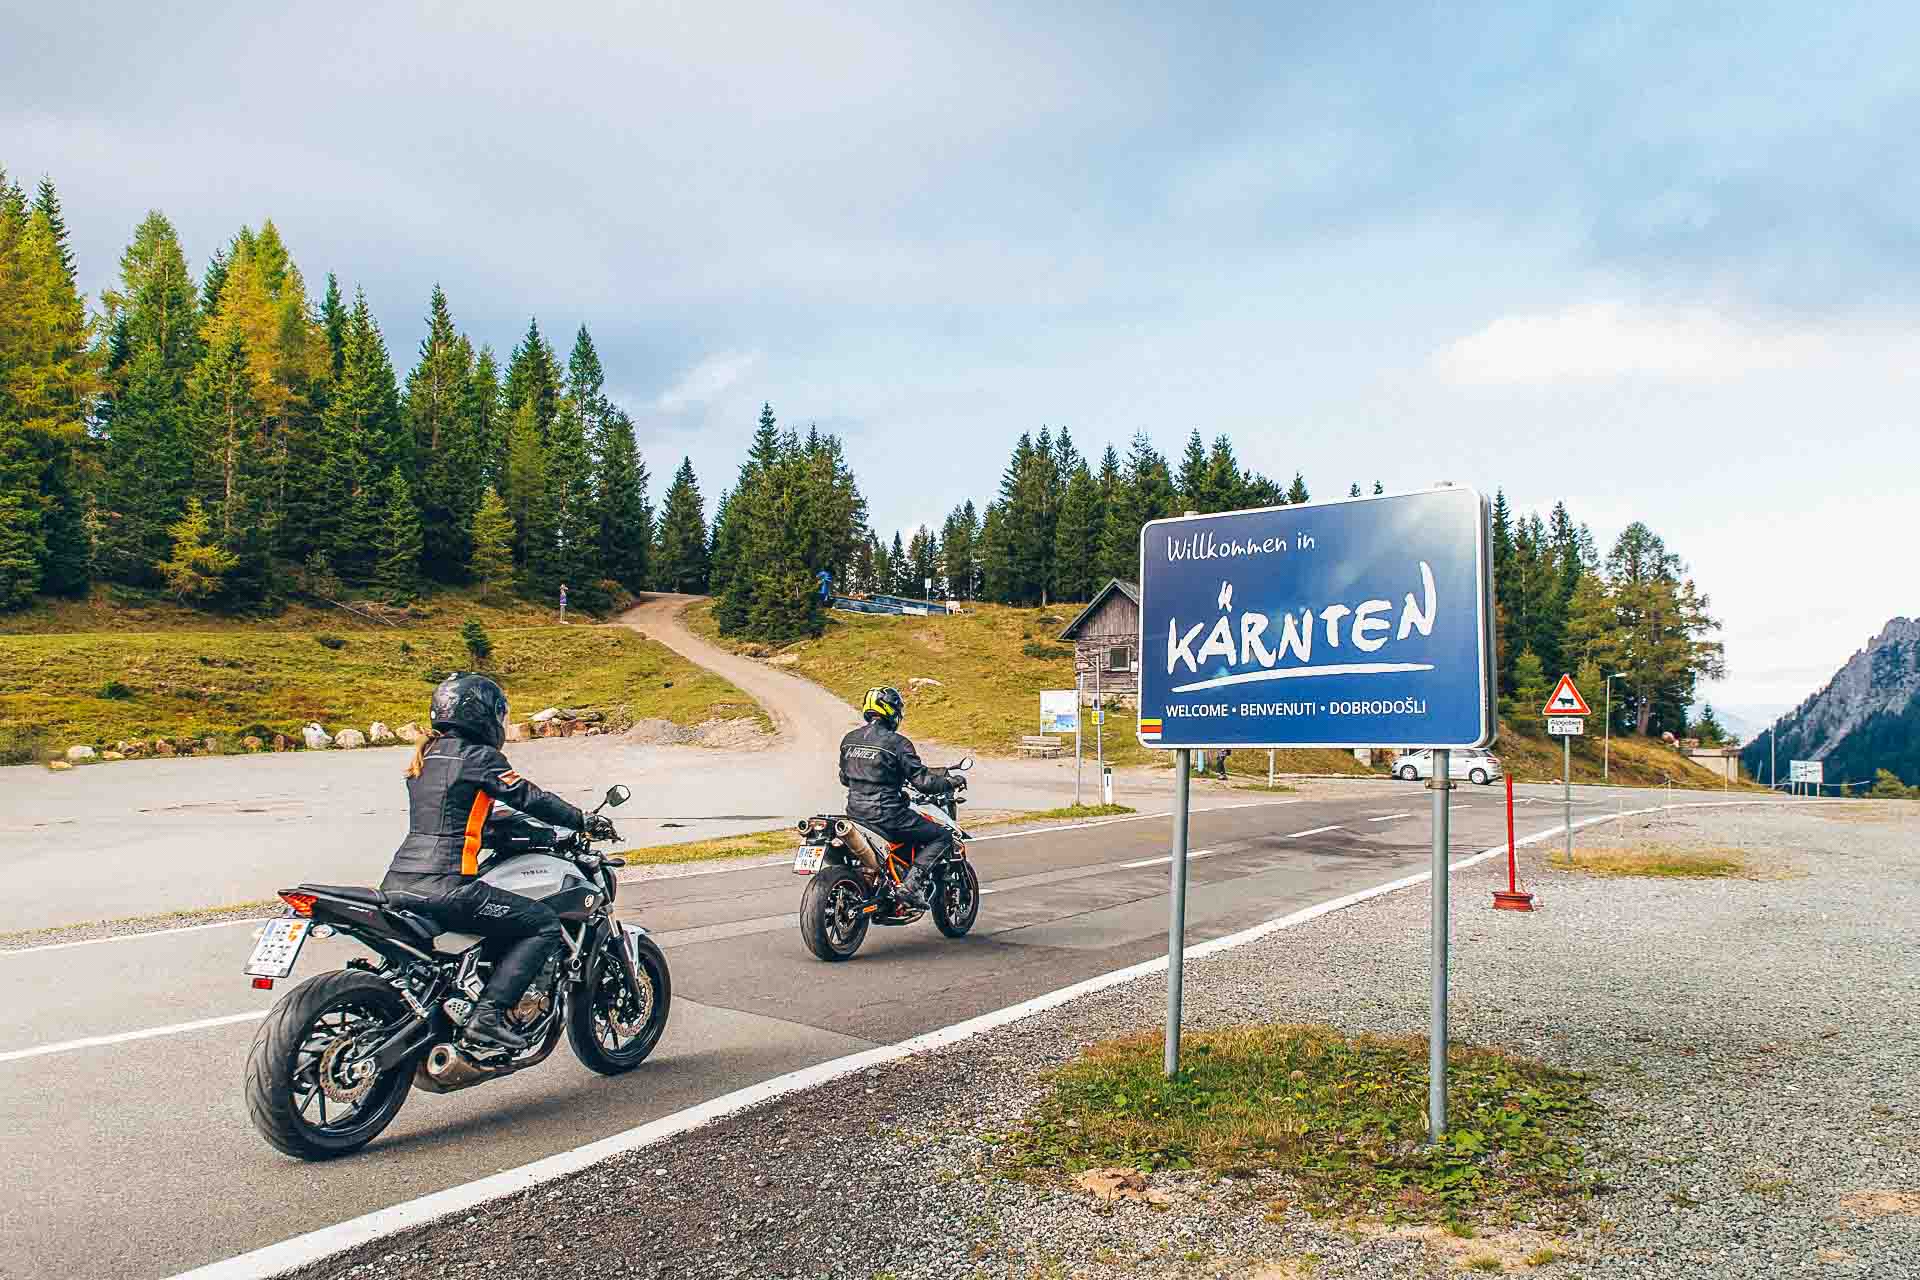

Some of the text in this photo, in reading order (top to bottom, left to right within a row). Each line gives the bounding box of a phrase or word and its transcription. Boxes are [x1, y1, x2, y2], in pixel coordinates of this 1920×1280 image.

[1167, 531, 1315, 562] Willkommen in
[1166, 697, 1426, 718] WELCOME BENVENUTI DOBRODOŠLI
